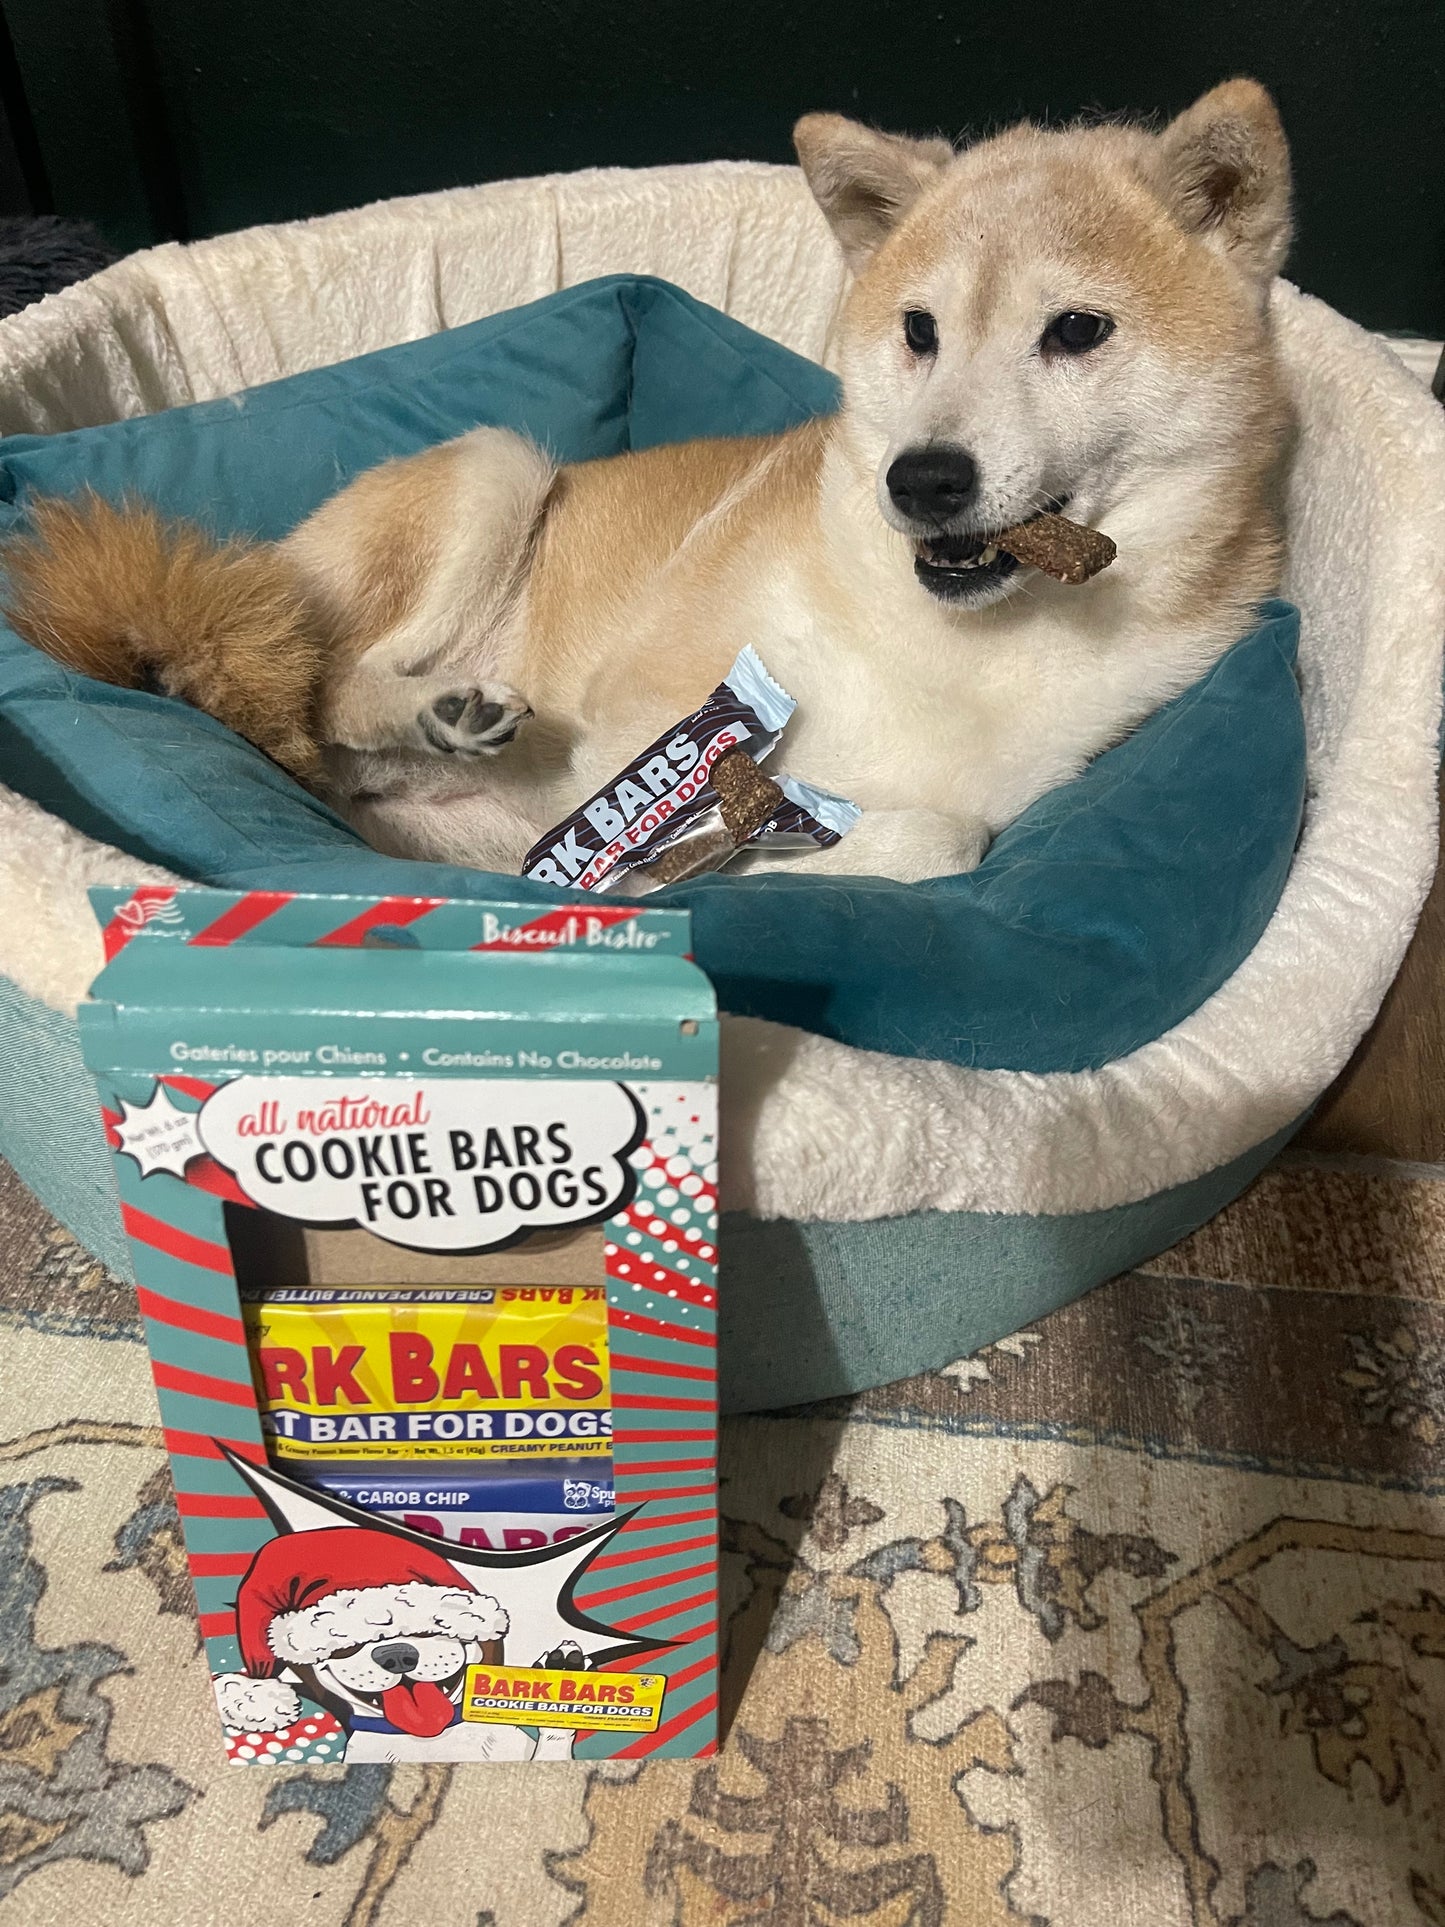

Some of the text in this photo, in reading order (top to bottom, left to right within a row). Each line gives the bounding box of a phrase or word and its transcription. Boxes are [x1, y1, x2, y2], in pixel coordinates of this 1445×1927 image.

[583, 733, 699, 843] BARS
[579, 731, 737, 890] BAR FOR DOGS
[482, 911, 581, 946] Biscuit
[262, 1049, 313, 1067] pour
[315, 1045, 386, 1065] Chiens
[422, 1047, 514, 1068] Contains
[518, 1051, 552, 1069] No
[556, 1051, 663, 1071] Chocolate
[237, 1091, 431, 1137] all natural
[255, 1122, 573, 1184] COOKIE BARS
[360, 1166, 608, 1222] FOR DOGS
[336, 1289, 414, 1301] PEANUT
[415, 1289, 494, 1301] CREAMY
[502, 1288, 575, 1304] BARS
[389, 1331, 604, 1404] BARS
[310, 1415, 396, 1441] BAR
[408, 1412, 493, 1440] FOR
[490, 1444, 546, 1454] CREAMY
[549, 1442, 603, 1452] PEANUT
[357, 1490, 421, 1504] CAROB
[425, 1491, 470, 1505] CHIP
[473, 1673, 553, 1699] BARK
[559, 1679, 635, 1704] BARS
[473, 1698, 652, 1716] COOKIE BAR FOR DOGS
